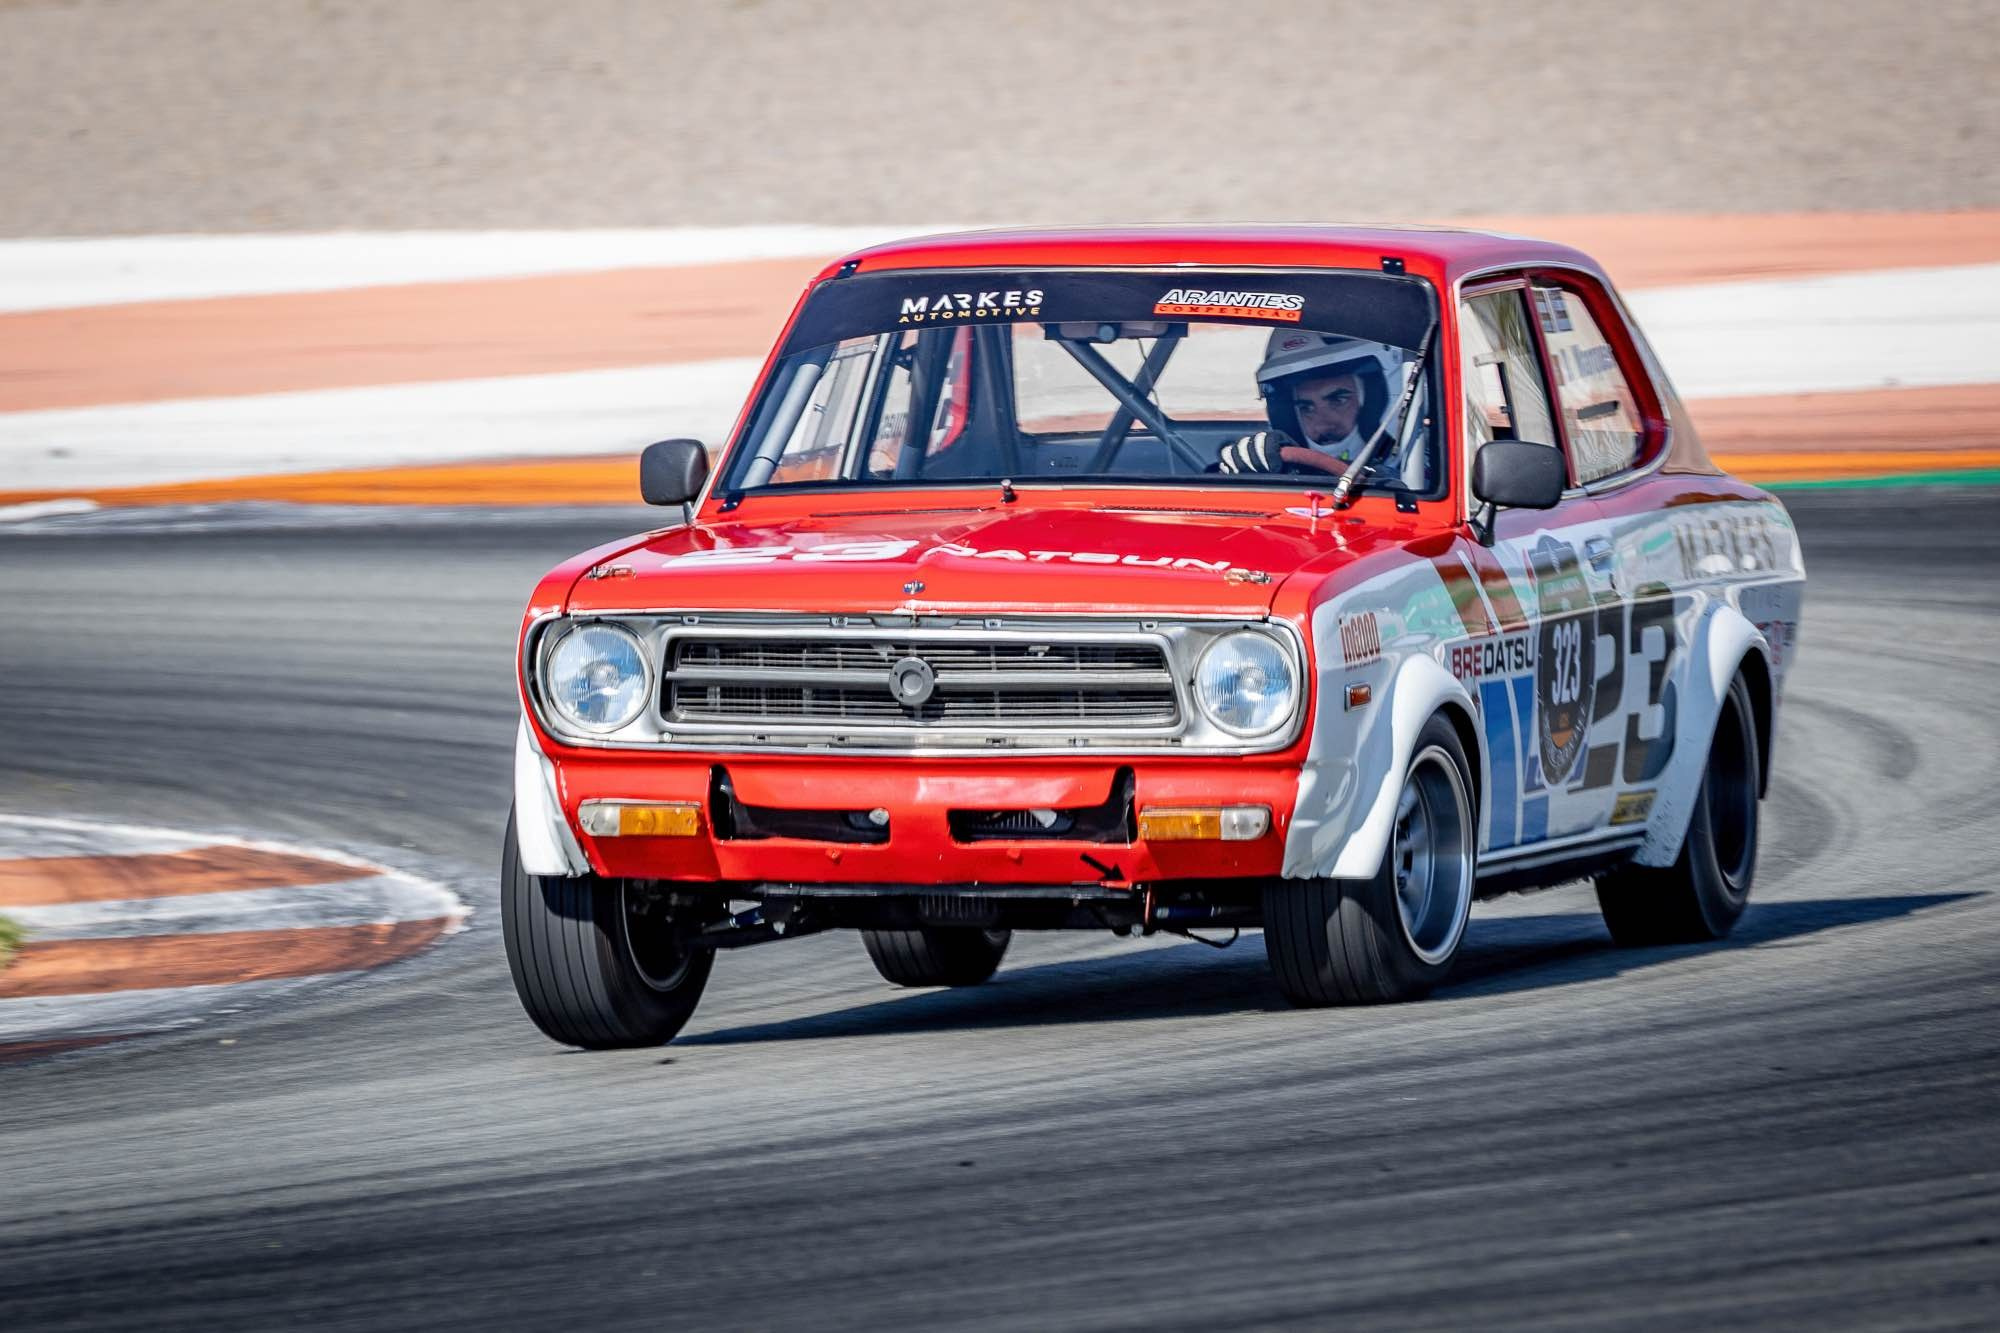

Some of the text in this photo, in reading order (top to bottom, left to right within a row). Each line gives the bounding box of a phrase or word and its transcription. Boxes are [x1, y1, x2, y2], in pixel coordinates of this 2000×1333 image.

[901, 289, 1044, 315] MARKES
[1156, 289, 1305, 311] ARANTES
[898, 306, 1041, 323] AUTOMOTIVE
[1551, 619, 1582, 706] 323
